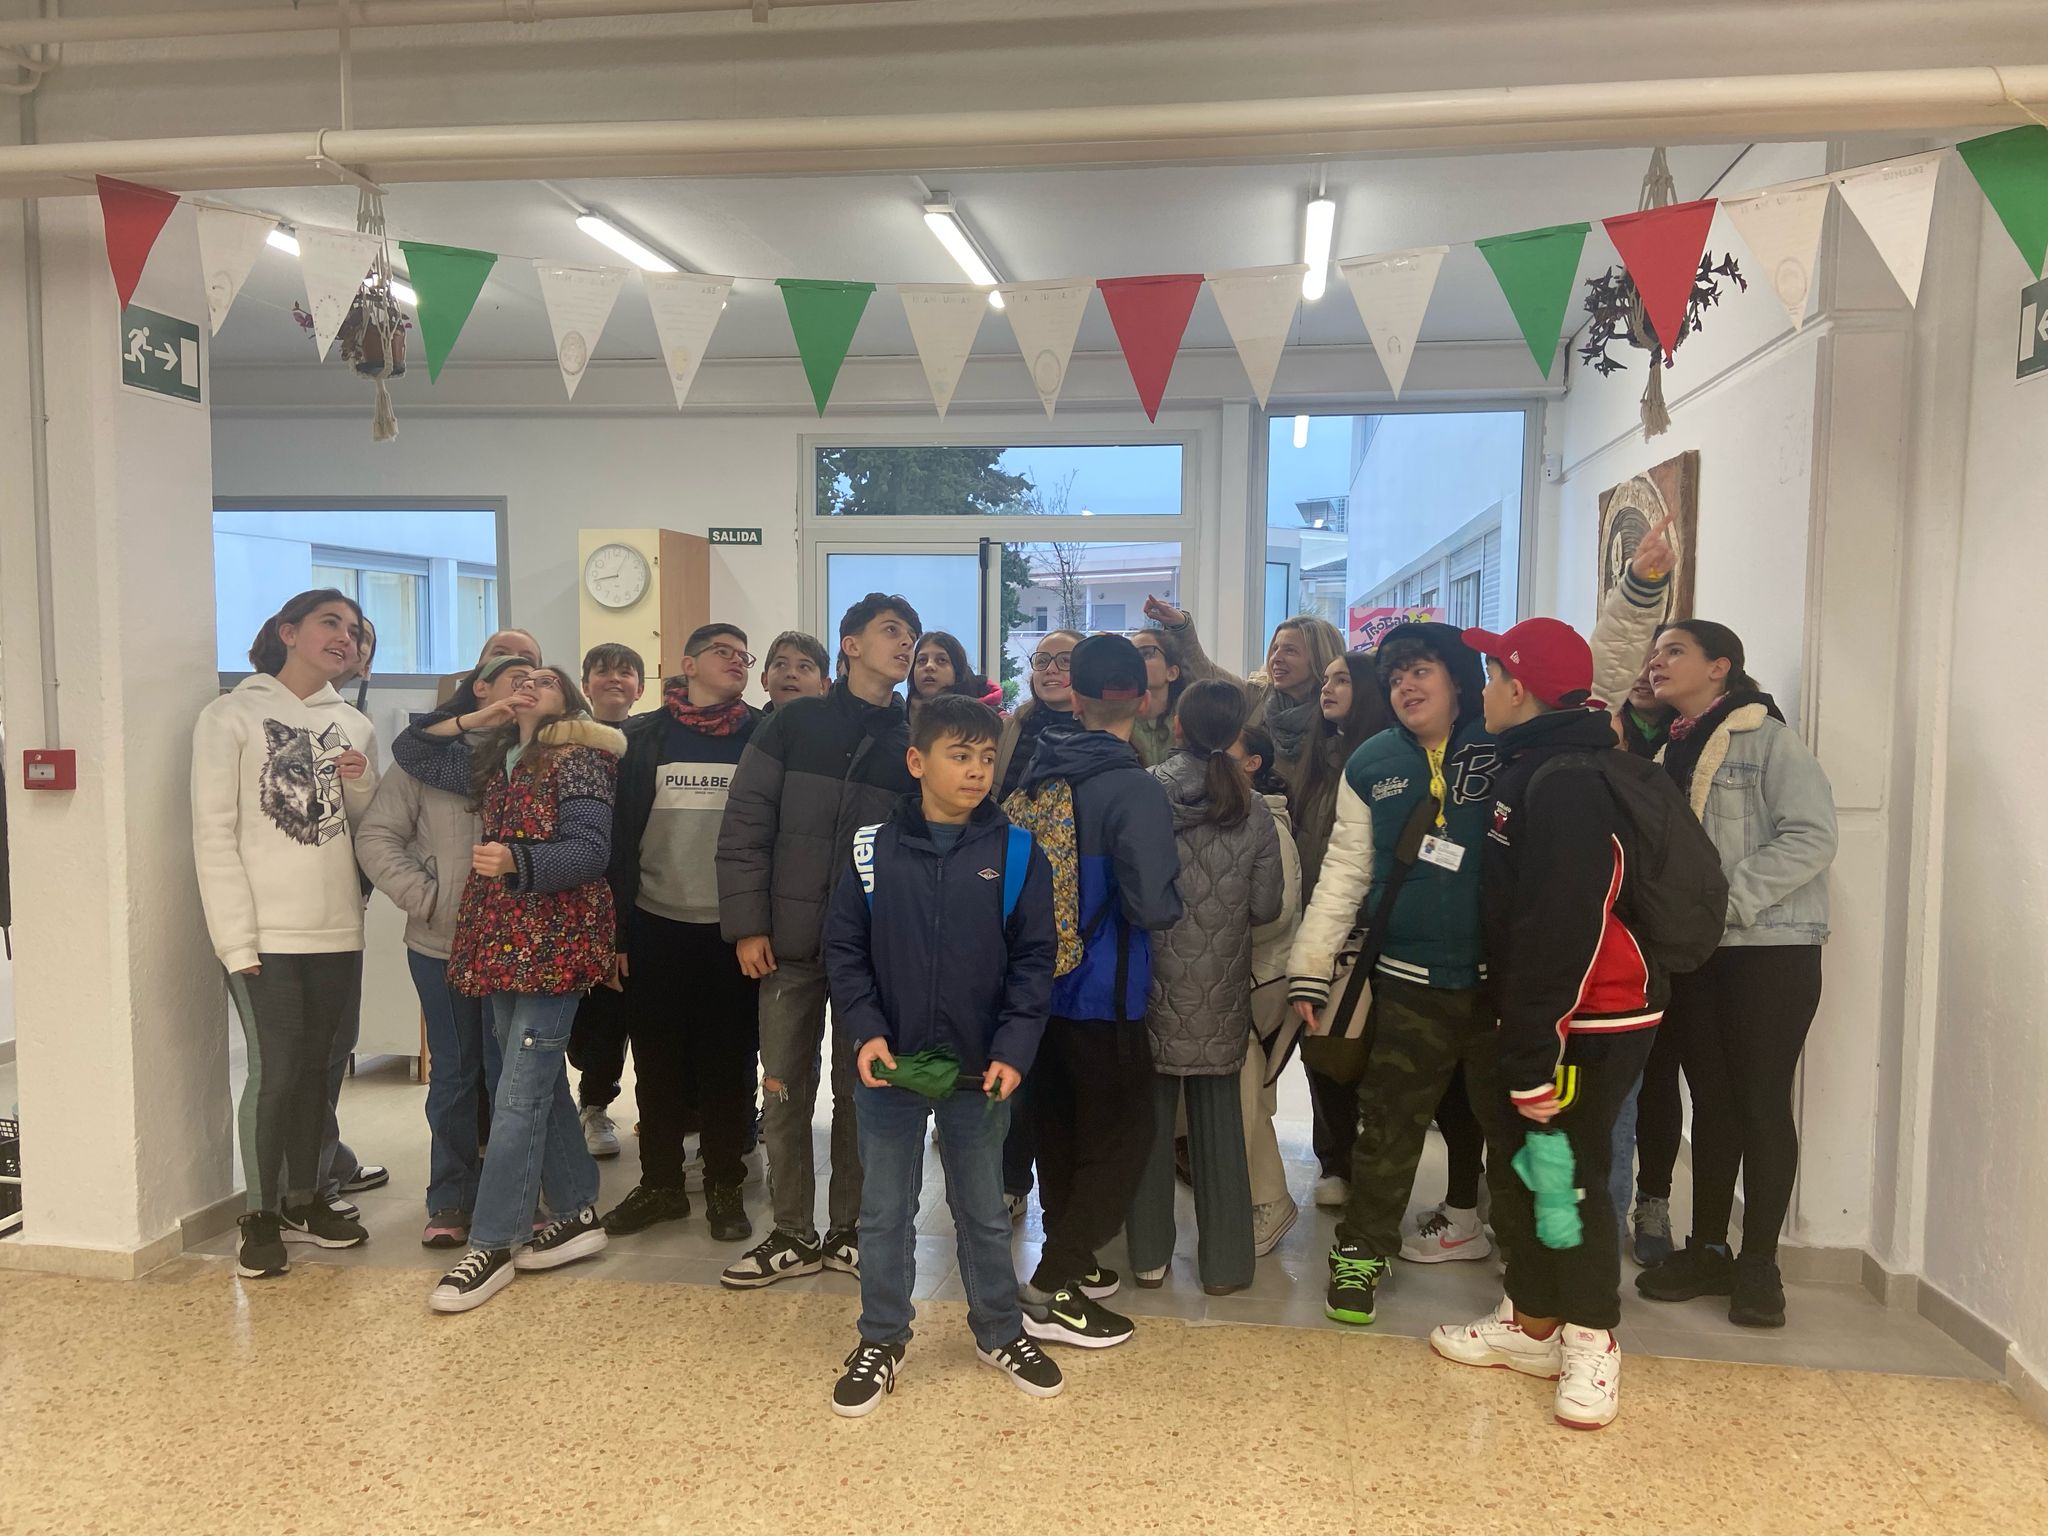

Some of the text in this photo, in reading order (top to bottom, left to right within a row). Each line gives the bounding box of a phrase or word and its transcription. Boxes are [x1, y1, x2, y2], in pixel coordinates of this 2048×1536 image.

[712, 530, 758, 542] SALIDA
[665, 775, 729, 788] PULL&BE
[1450, 743, 1503, 805] B
[853, 823, 885, 894] aren
